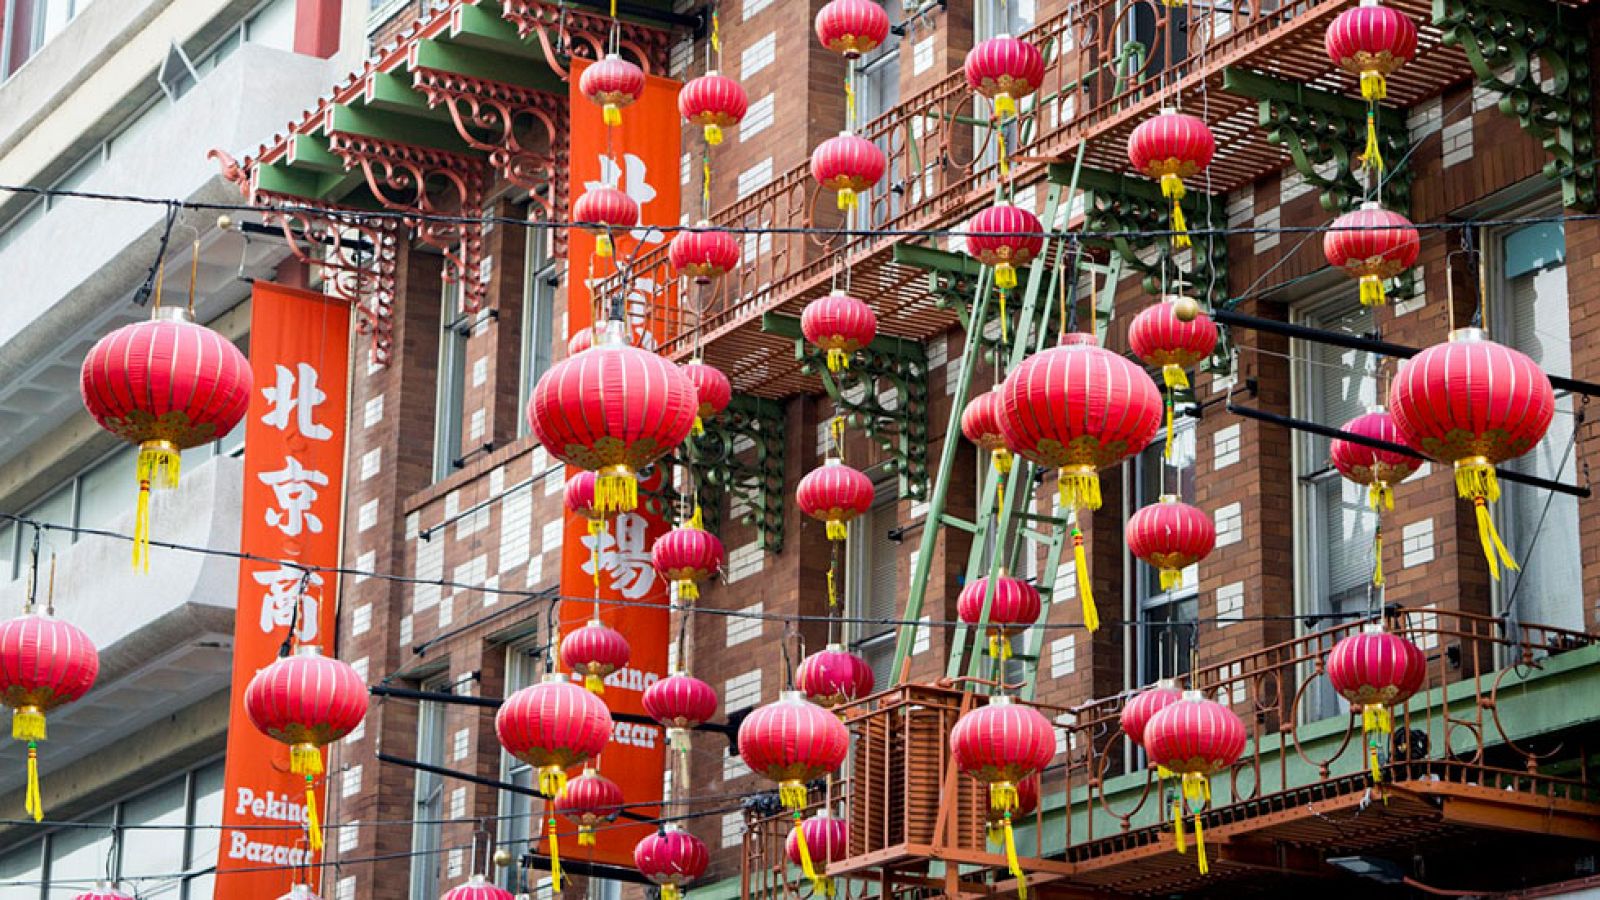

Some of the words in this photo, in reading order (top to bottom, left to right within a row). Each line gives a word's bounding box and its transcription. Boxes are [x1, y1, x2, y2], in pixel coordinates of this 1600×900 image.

[252, 362, 334, 674] 北京商
[609, 721, 658, 749] aar
[235, 787, 312, 830] Peking
[230, 830, 313, 867] Bazaar
